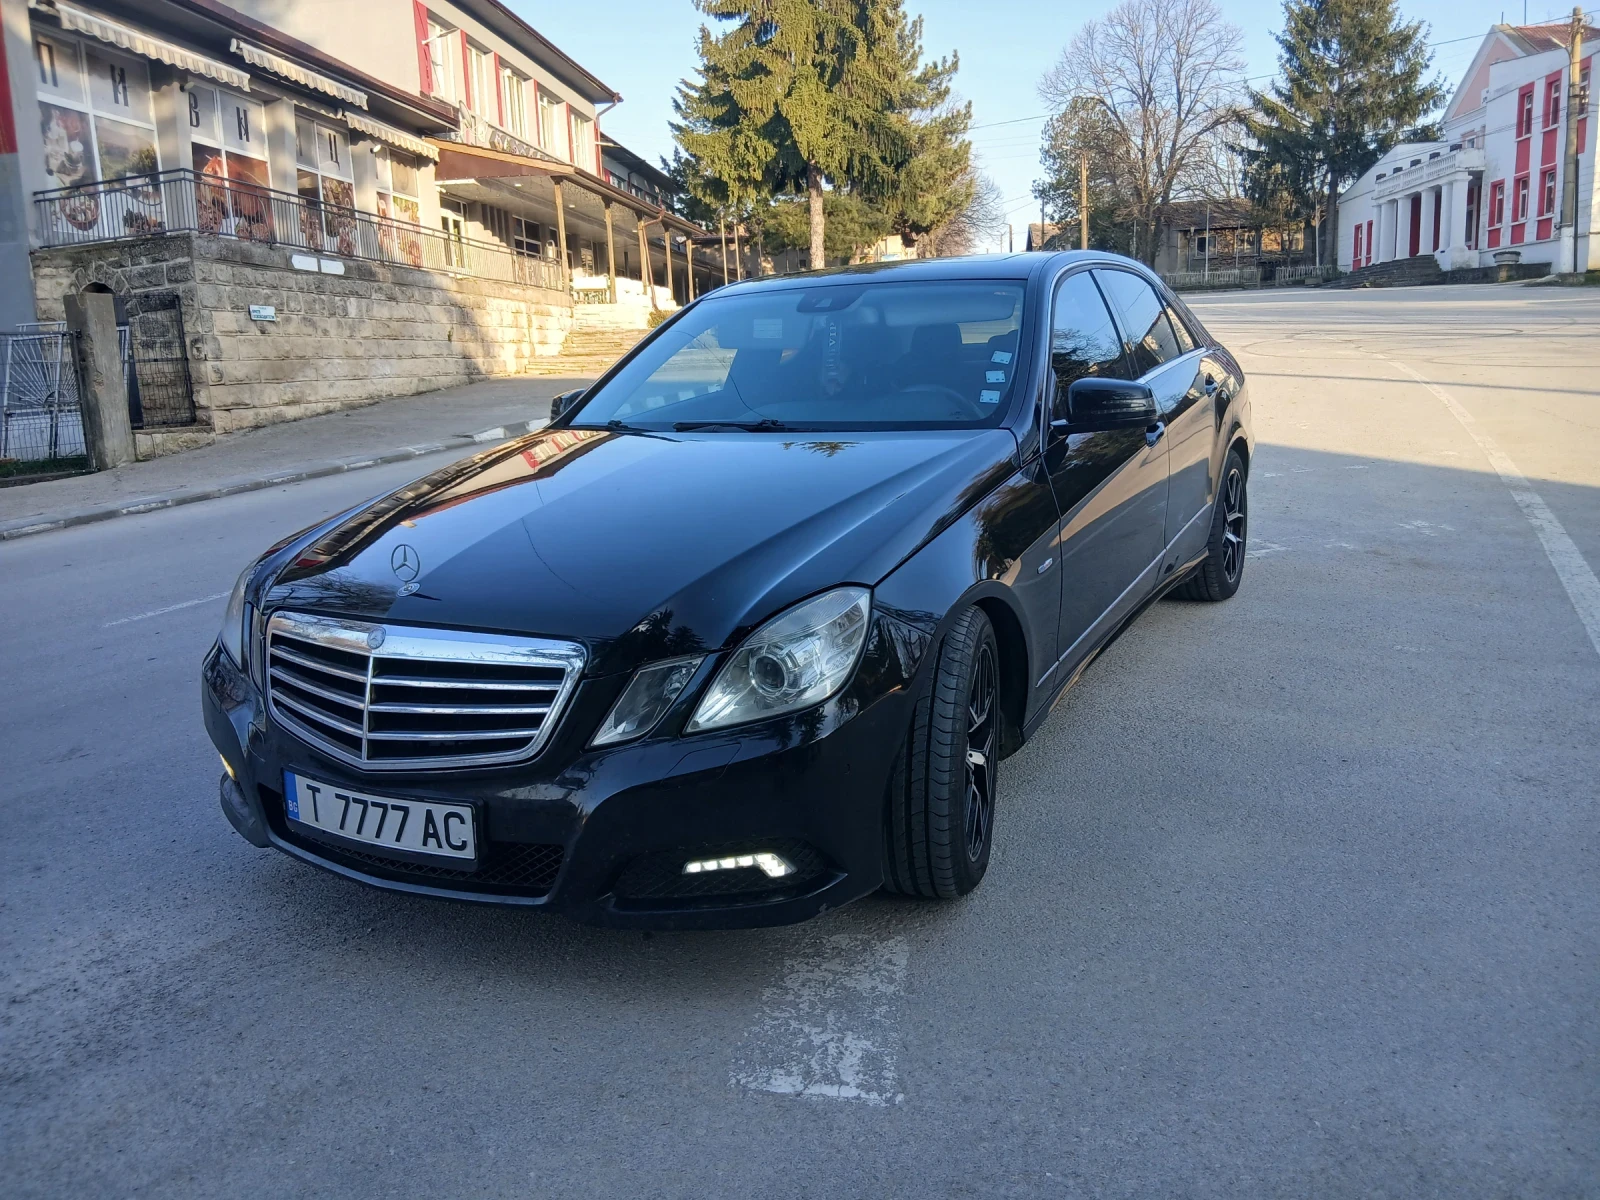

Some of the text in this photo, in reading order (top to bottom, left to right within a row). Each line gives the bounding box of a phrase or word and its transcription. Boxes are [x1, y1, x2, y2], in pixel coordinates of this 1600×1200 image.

[288, 799, 298, 813] BG
[306, 783, 468, 851] T 7777 AC
